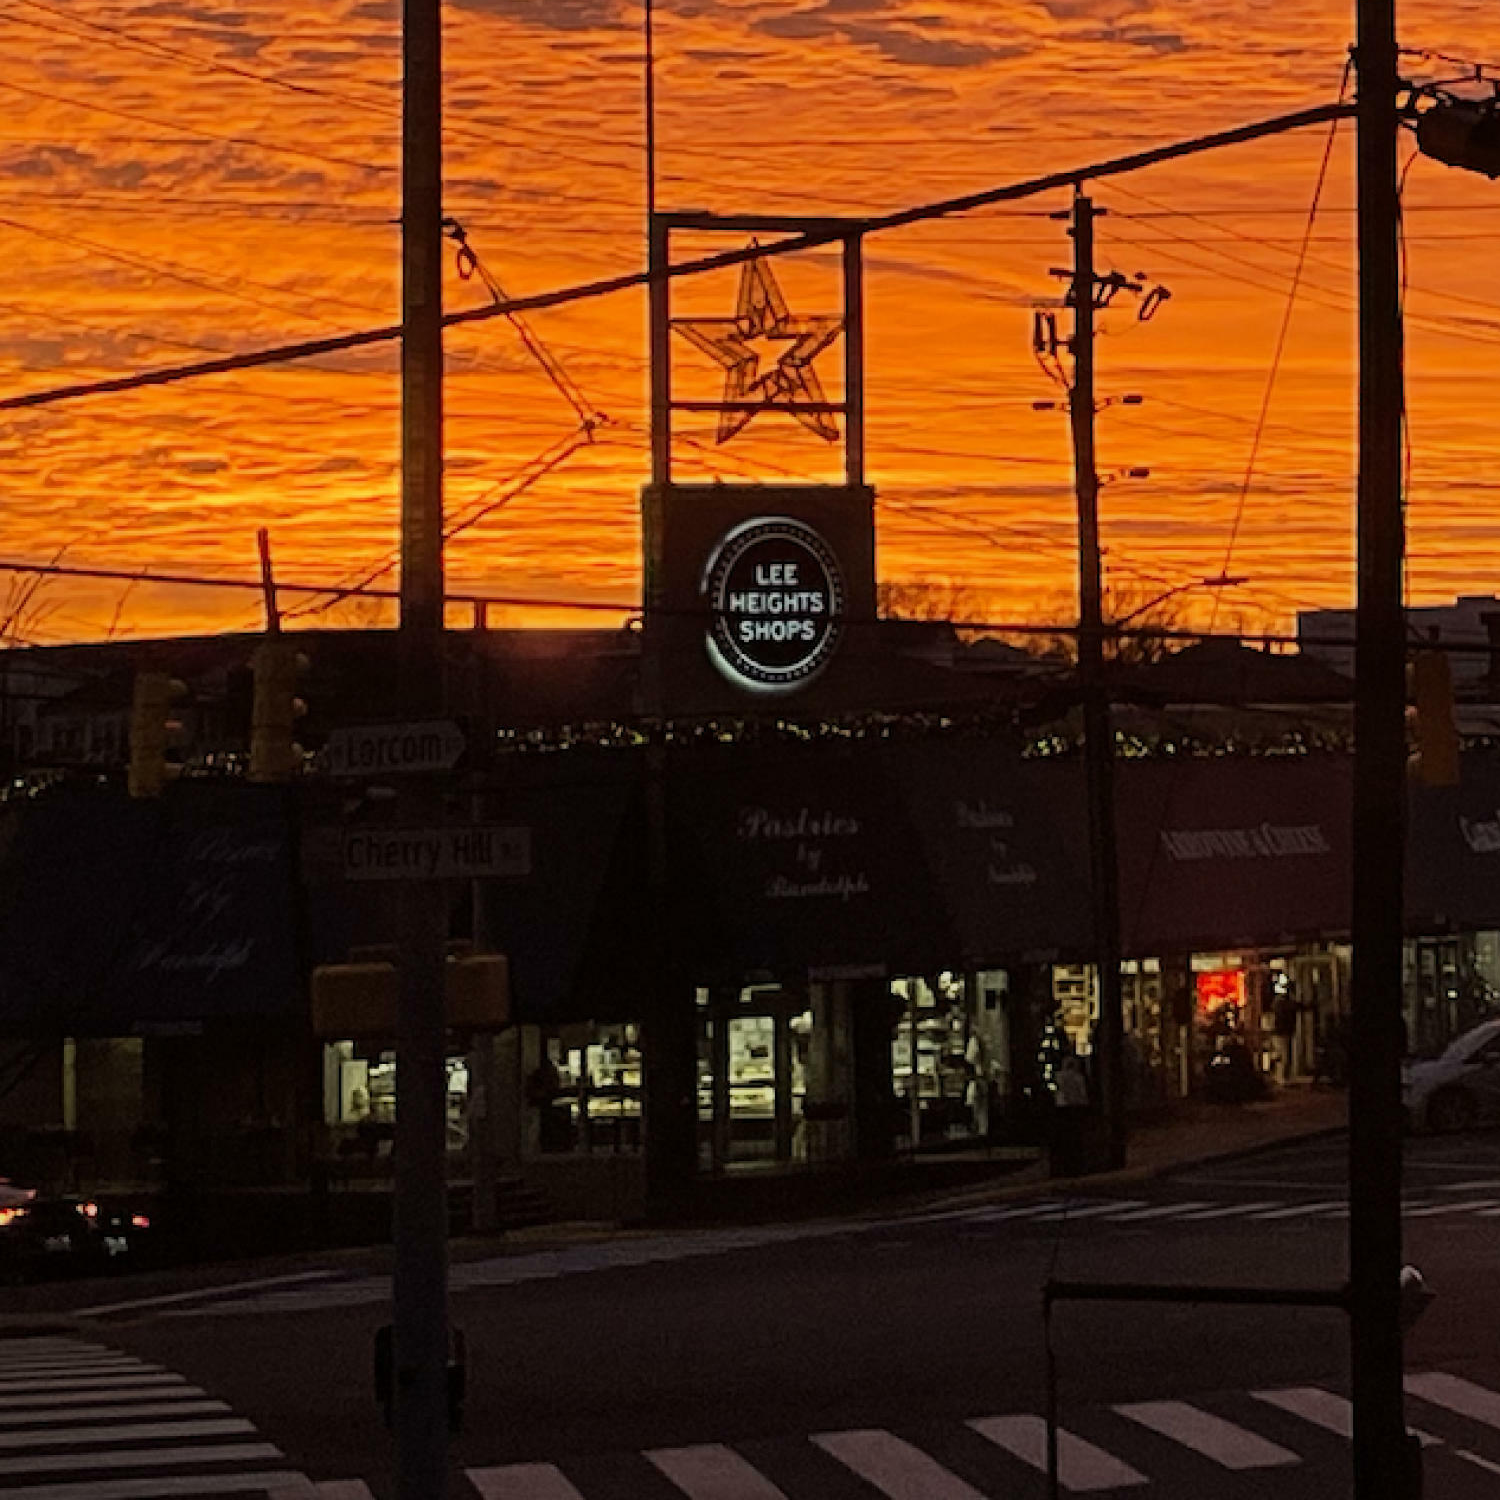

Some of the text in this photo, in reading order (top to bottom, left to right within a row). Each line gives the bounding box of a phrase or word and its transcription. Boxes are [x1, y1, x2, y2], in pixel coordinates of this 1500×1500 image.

[755, 563, 799, 586] LEE
[729, 591, 824, 614] HEIGHTS
[738, 620, 816, 642] SHOPS
[737, 806, 861, 838] Pastries
[347, 835, 442, 874] Cherry
[454, 832, 492, 864] Hill
